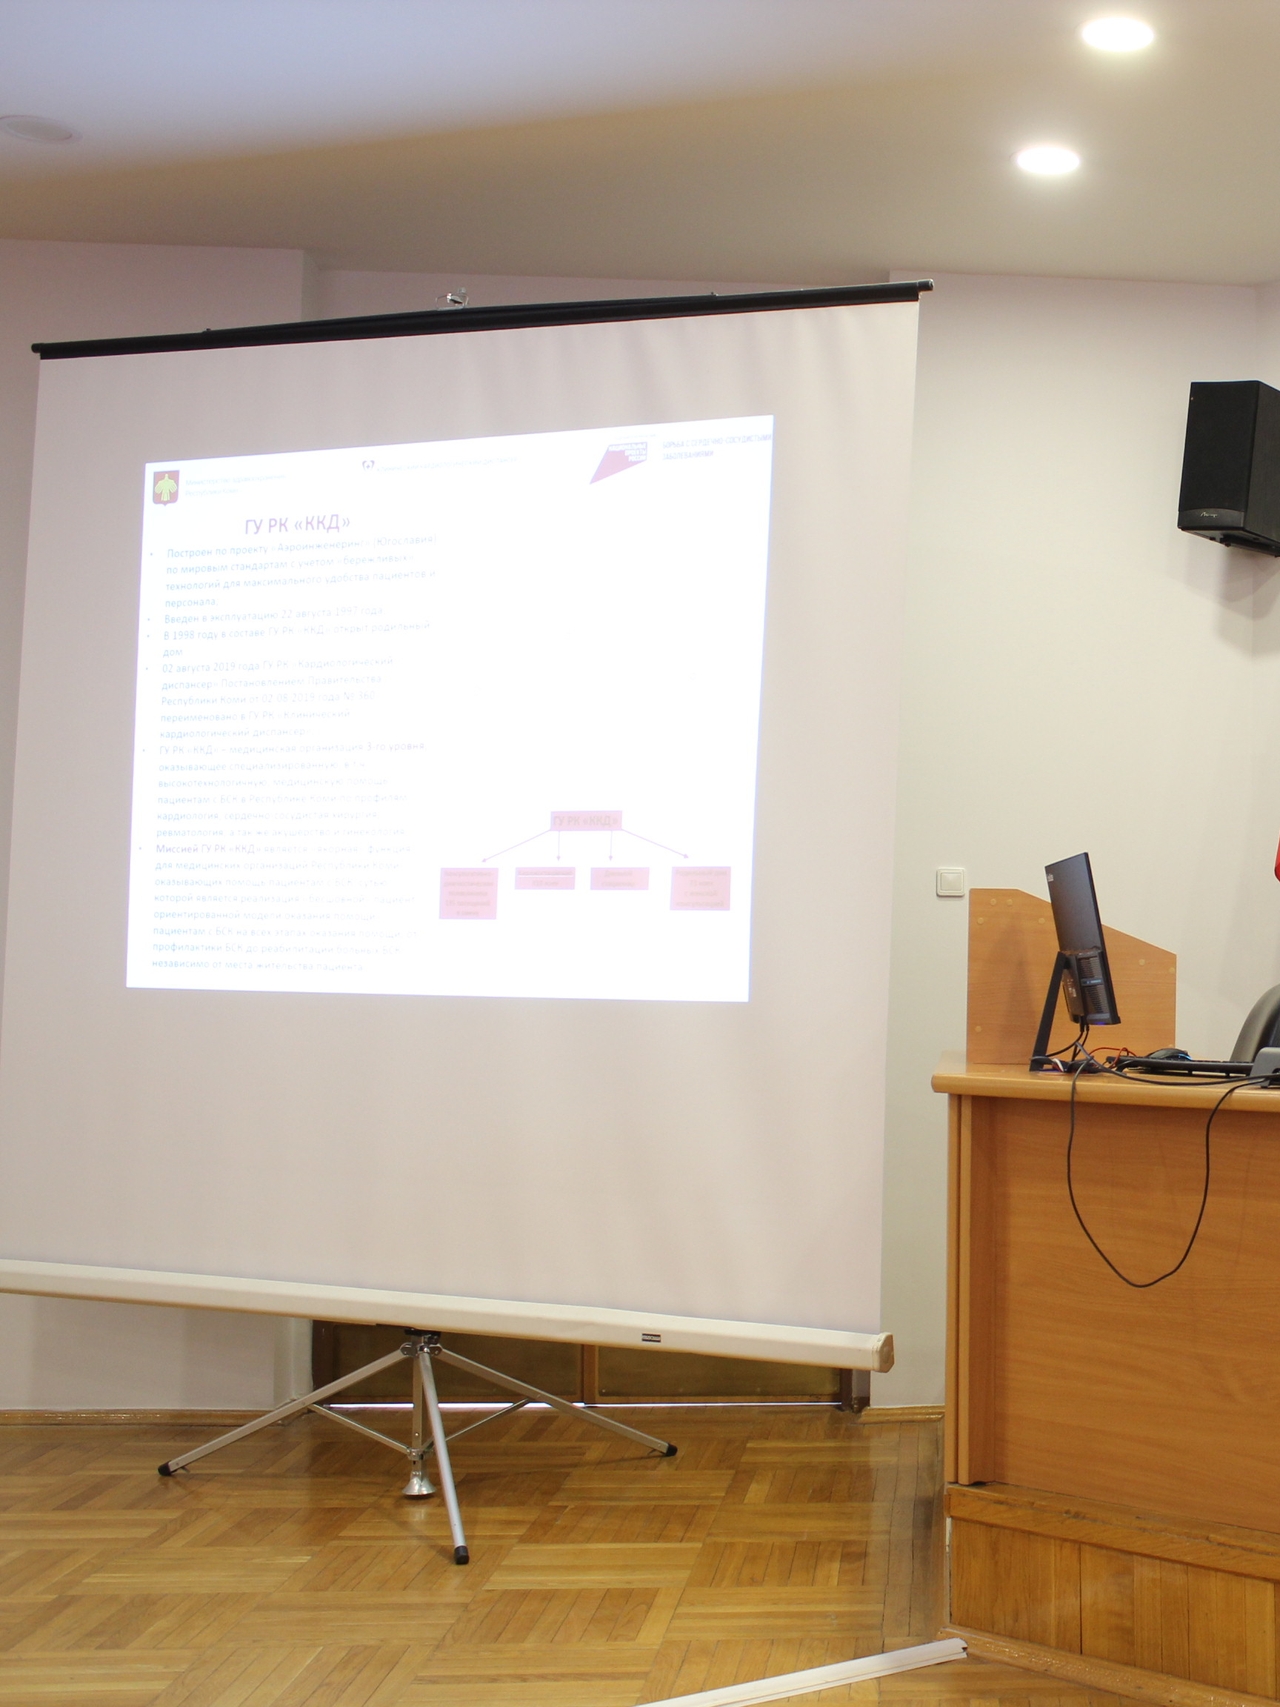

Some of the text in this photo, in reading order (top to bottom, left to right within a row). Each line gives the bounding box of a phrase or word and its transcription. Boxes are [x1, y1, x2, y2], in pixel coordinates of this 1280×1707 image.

[245, 514, 350, 534] ГУ РК «ККД»
[167, 547, 213, 561] Построен
[229, 546, 268, 557] проекту
[181, 564, 228, 576] мировым
[230, 560, 288, 573] стандартам
[166, 578, 220, 590] технологий
[223, 580, 240, 589] для
[164, 613, 199, 625] Введен
